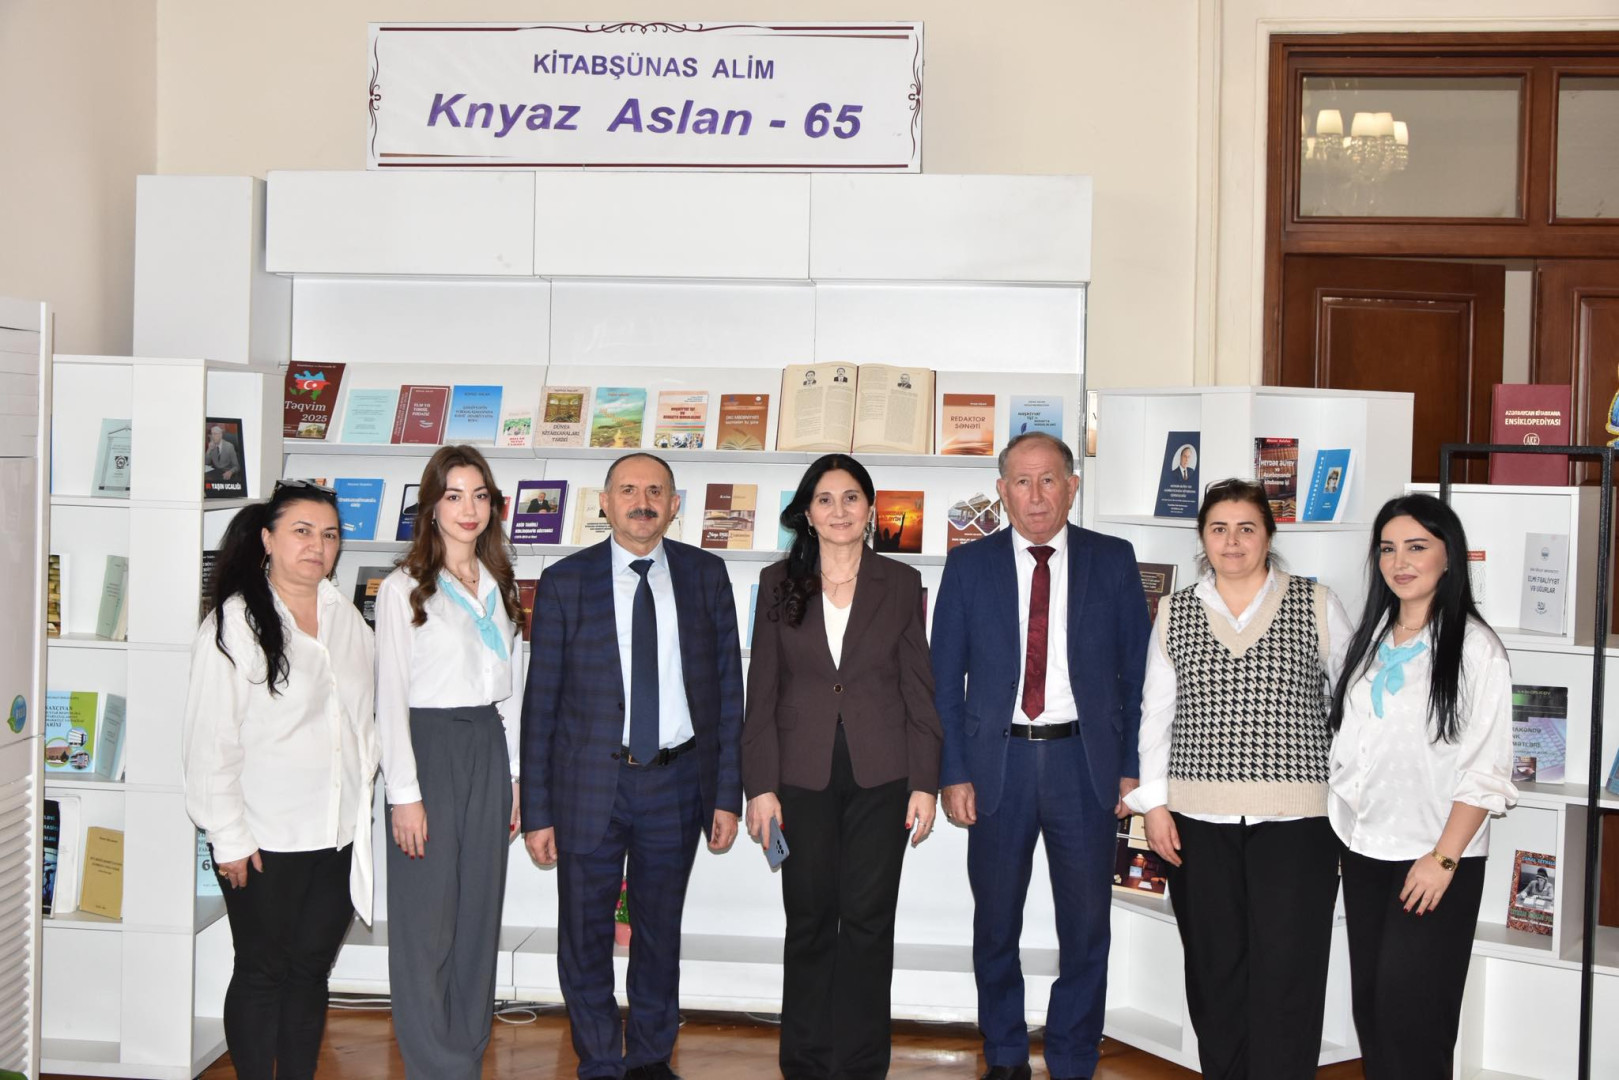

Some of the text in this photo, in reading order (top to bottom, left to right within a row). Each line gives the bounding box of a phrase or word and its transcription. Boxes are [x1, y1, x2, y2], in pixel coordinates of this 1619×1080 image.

[533, 51, 774, 80] KİTABŞÜNAS ALİM
[427, 93, 864, 140] Knyaz Aslan - 65
[285, 400, 326, 412] Təqvim
[301, 414, 328, 422] 2025
[1505, 417, 1561, 426] ENSİKLOPEDİYASI
